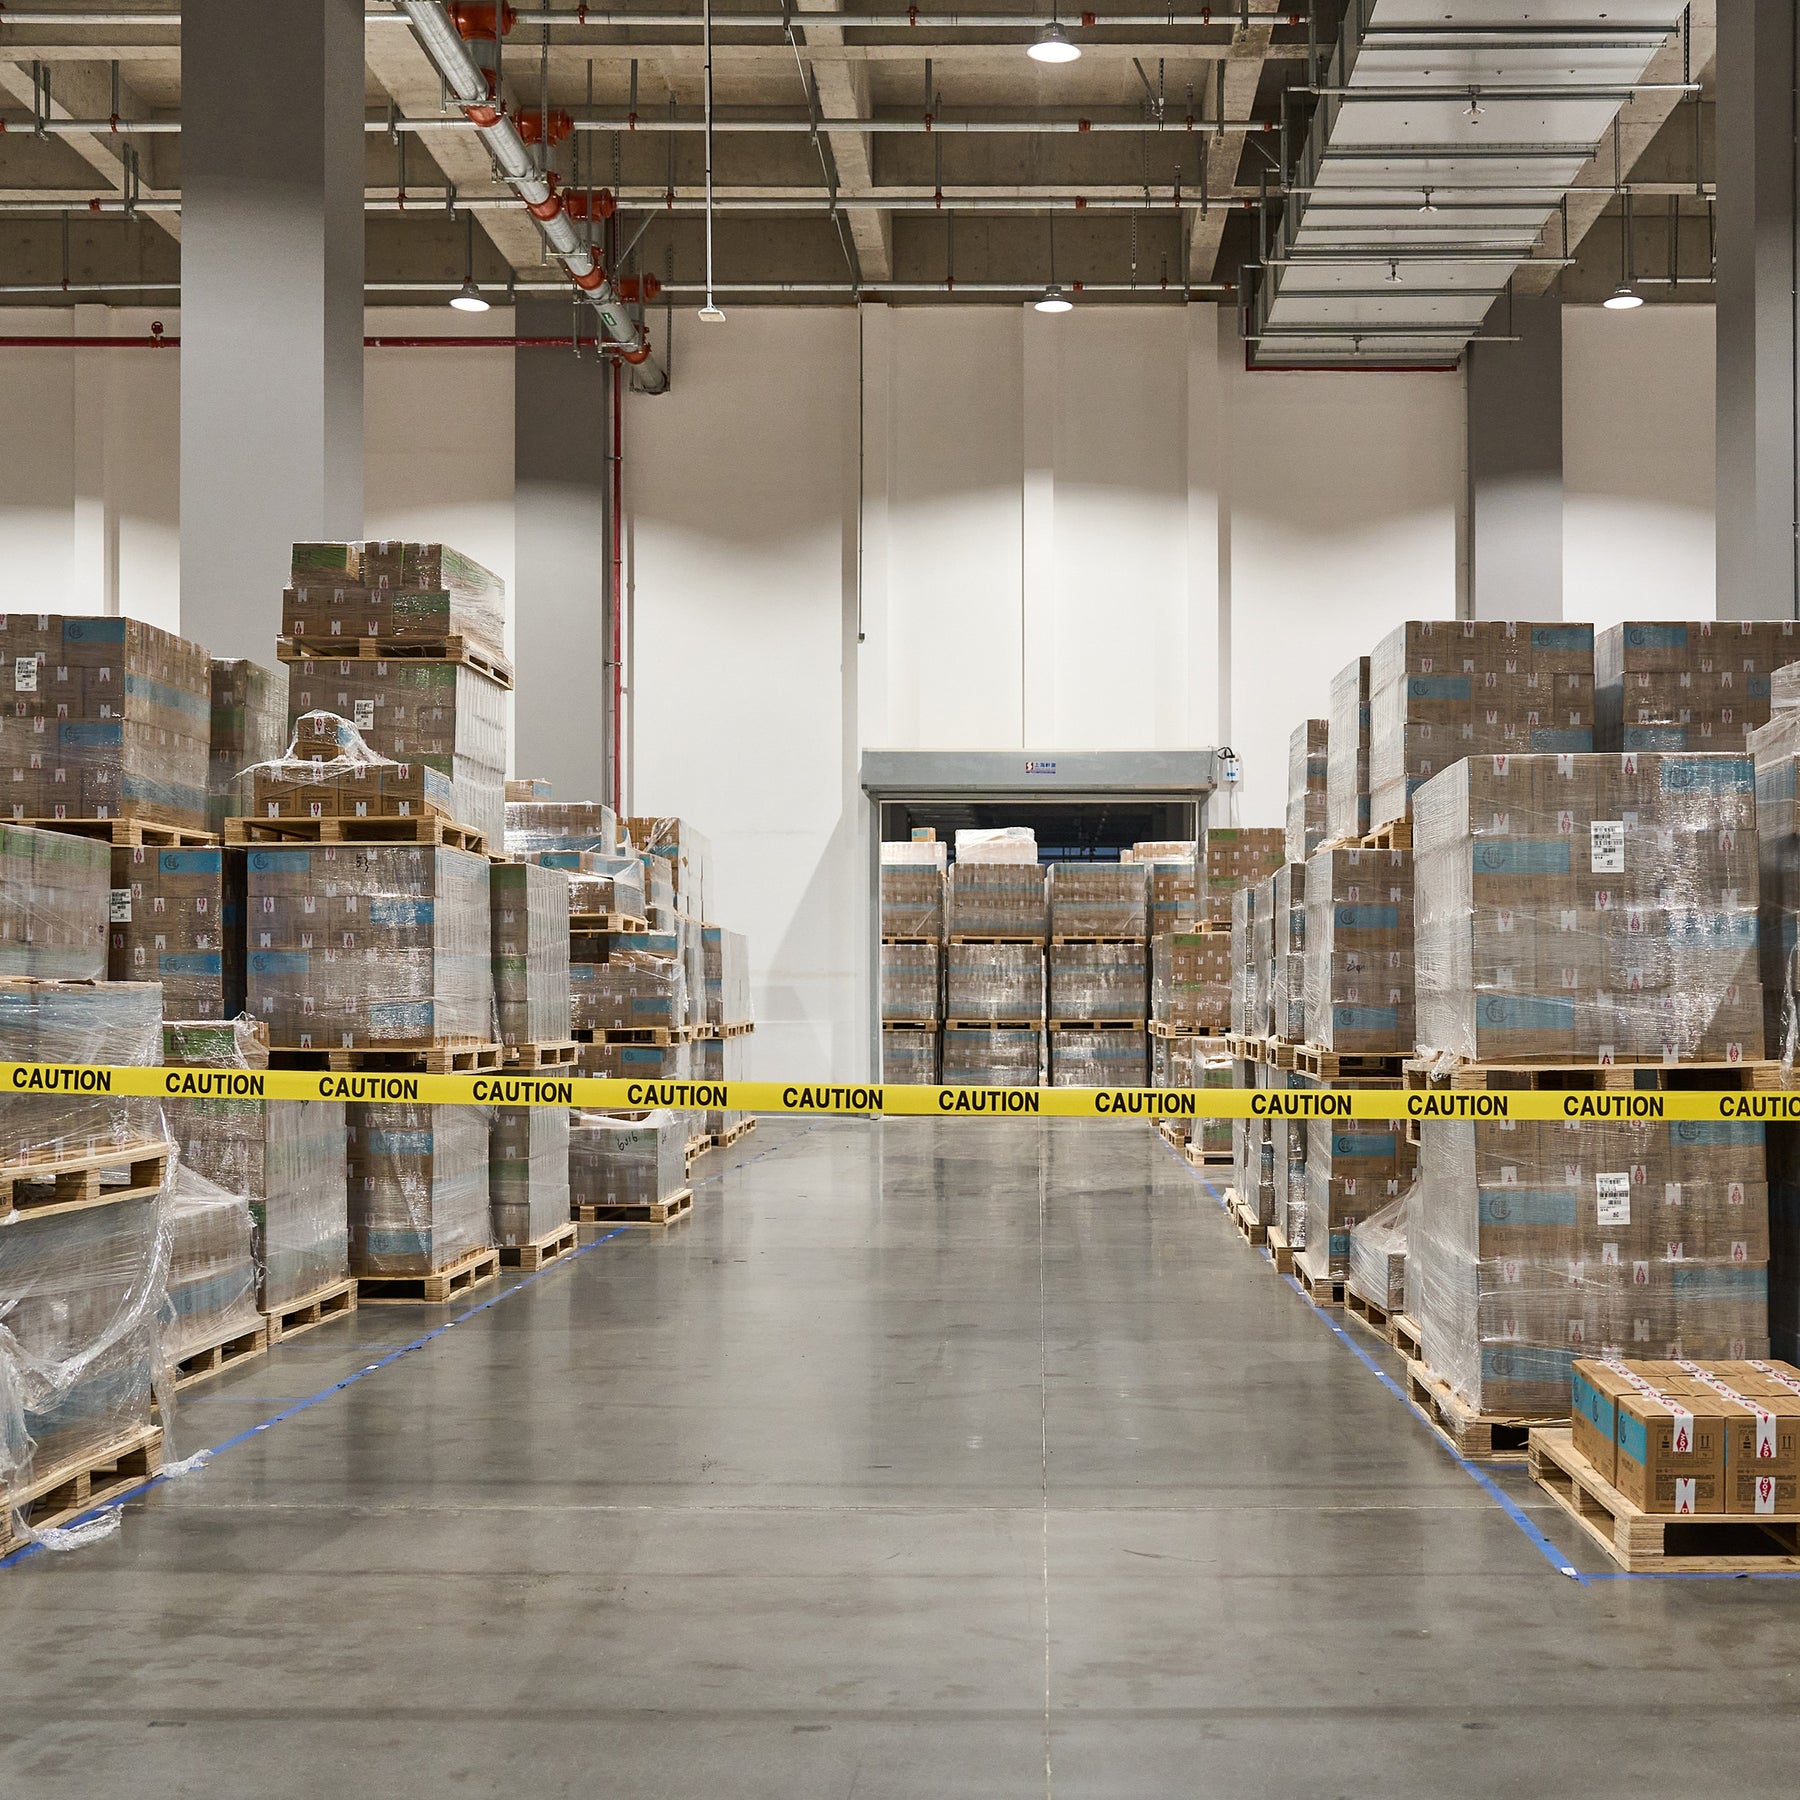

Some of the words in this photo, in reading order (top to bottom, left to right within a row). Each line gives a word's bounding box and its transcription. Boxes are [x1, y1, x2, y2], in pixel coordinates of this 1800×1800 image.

[12, 1067, 112, 1092] CAUTION
[165, 1072, 265, 1096] CAUTION
[318, 1076, 418, 1100] CAUTION
[472, 1080, 573, 1104] CAUTION
[627, 1084, 728, 1107] CAUTION
[782, 1087, 883, 1110] CAUTION
[938, 1090, 1039, 1112] CAUTION
[1094, 1092, 1196, 1114] CAUTION
[1251, 1093, 1352, 1116] CAUTION
[1407, 1094, 1508, 1117] CAUTION
[1563, 1095, 1664, 1117] CAUTION
[1719, 1096, 1800, 1118] CAUTIO
